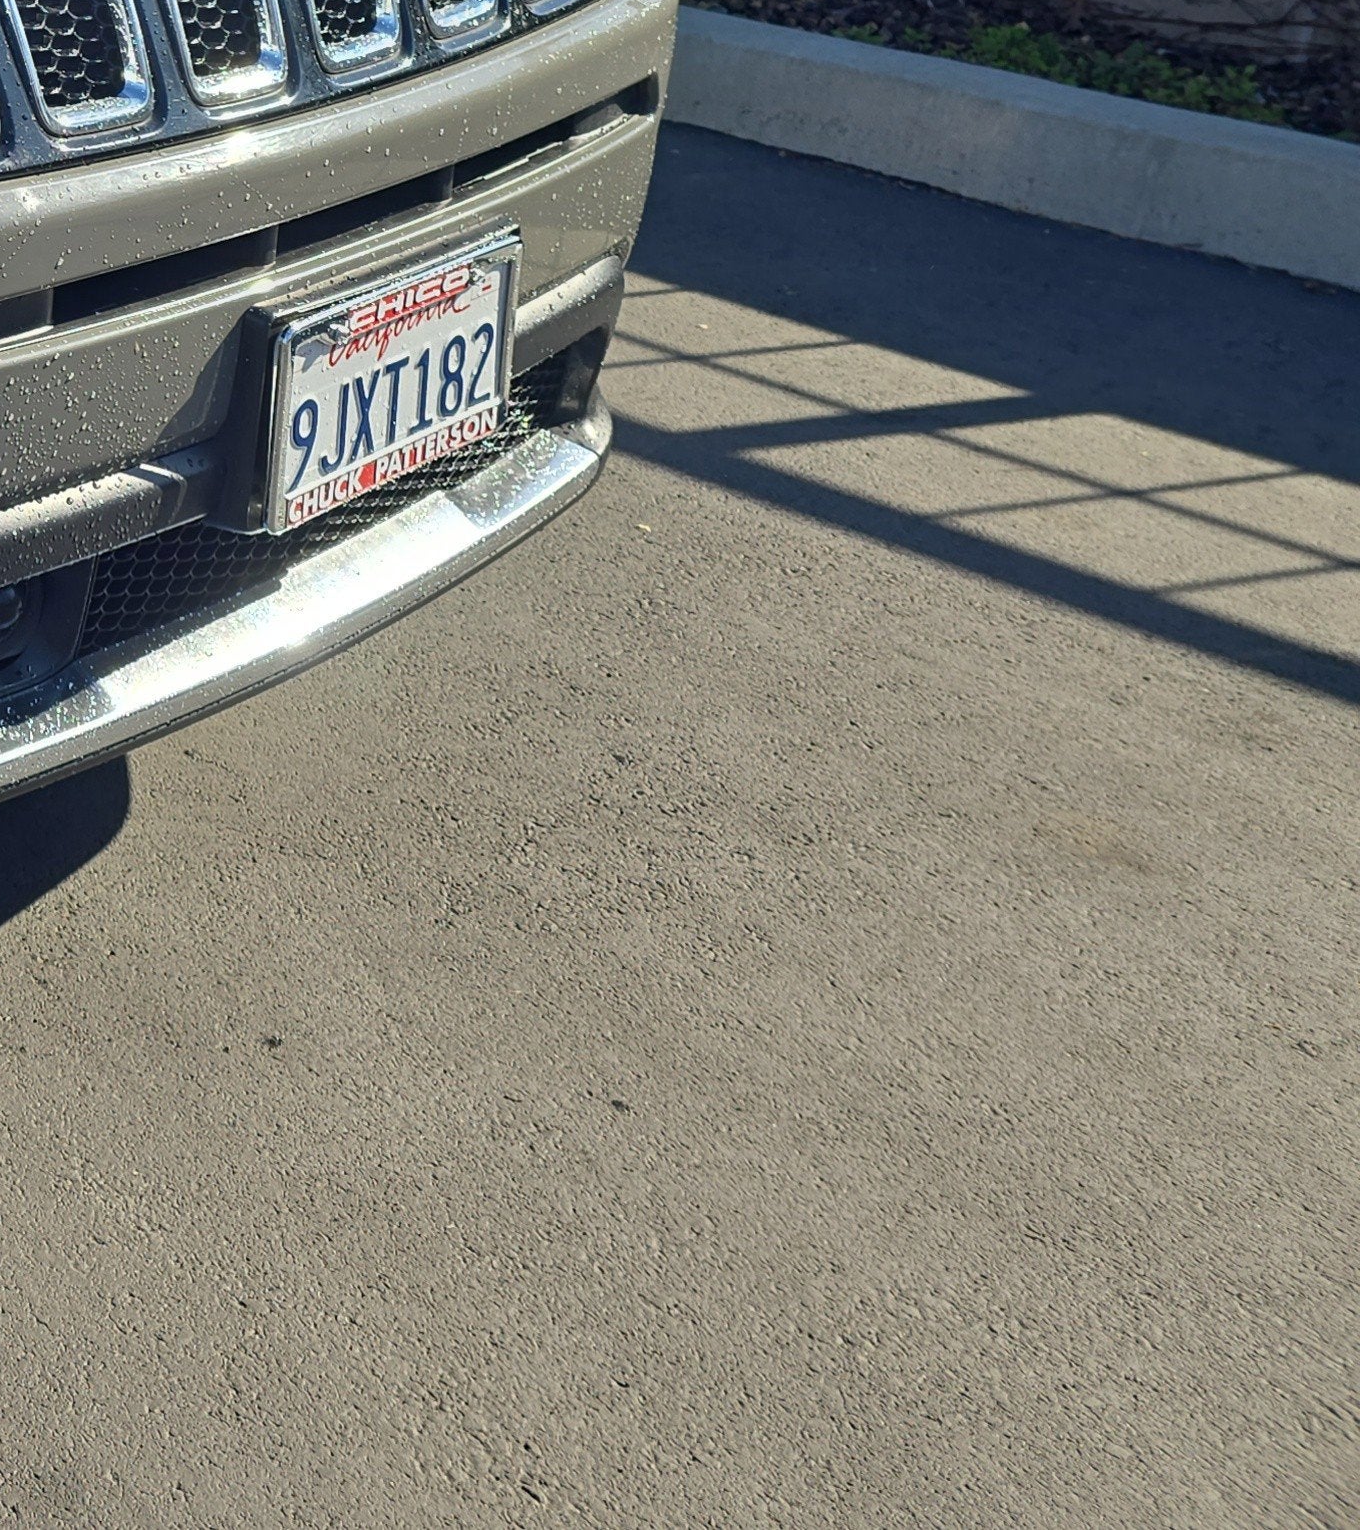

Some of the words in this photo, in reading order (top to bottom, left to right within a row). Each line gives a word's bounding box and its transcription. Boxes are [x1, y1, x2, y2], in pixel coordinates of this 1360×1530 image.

[349, 266, 470, 332] CHICO
[287, 322, 495, 493] 9JXT182
[288, 464, 365, 523] CHUCK
[375, 407, 497, 482] PATTERSON
